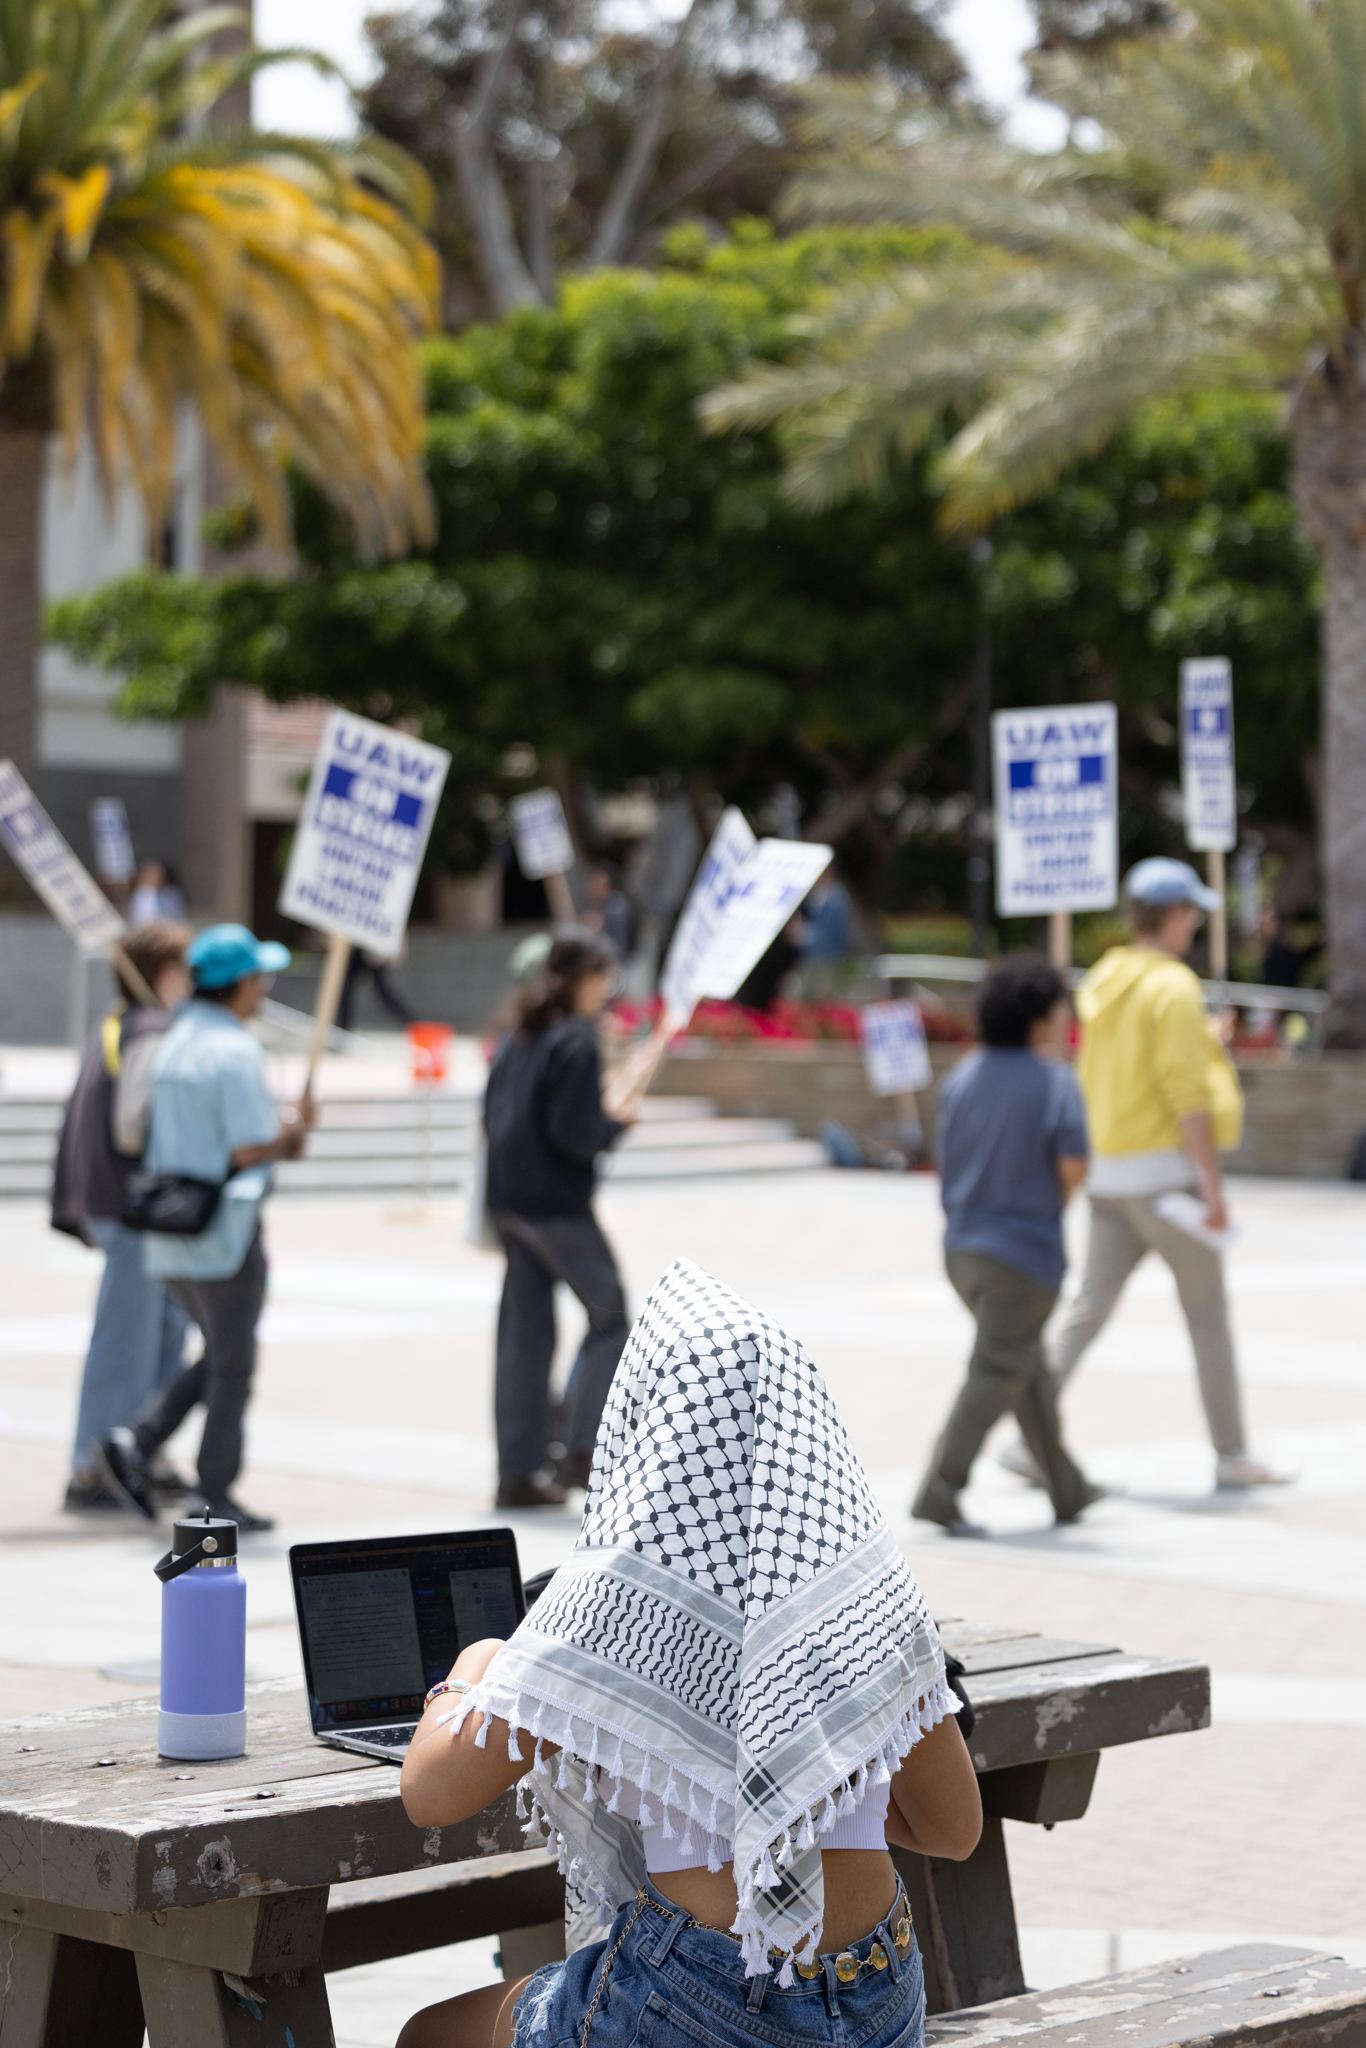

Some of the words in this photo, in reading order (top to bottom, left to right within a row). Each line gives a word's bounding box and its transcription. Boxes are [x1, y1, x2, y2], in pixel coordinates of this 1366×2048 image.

[1007, 722, 1106, 746] UAW
[336, 728, 435, 784] UAW
[1036, 759, 1079, 784] ON
[349, 775, 398, 818] ON
[1010, 789, 1104, 817] STRIKE
[318, 796, 415, 855] STRIKE
